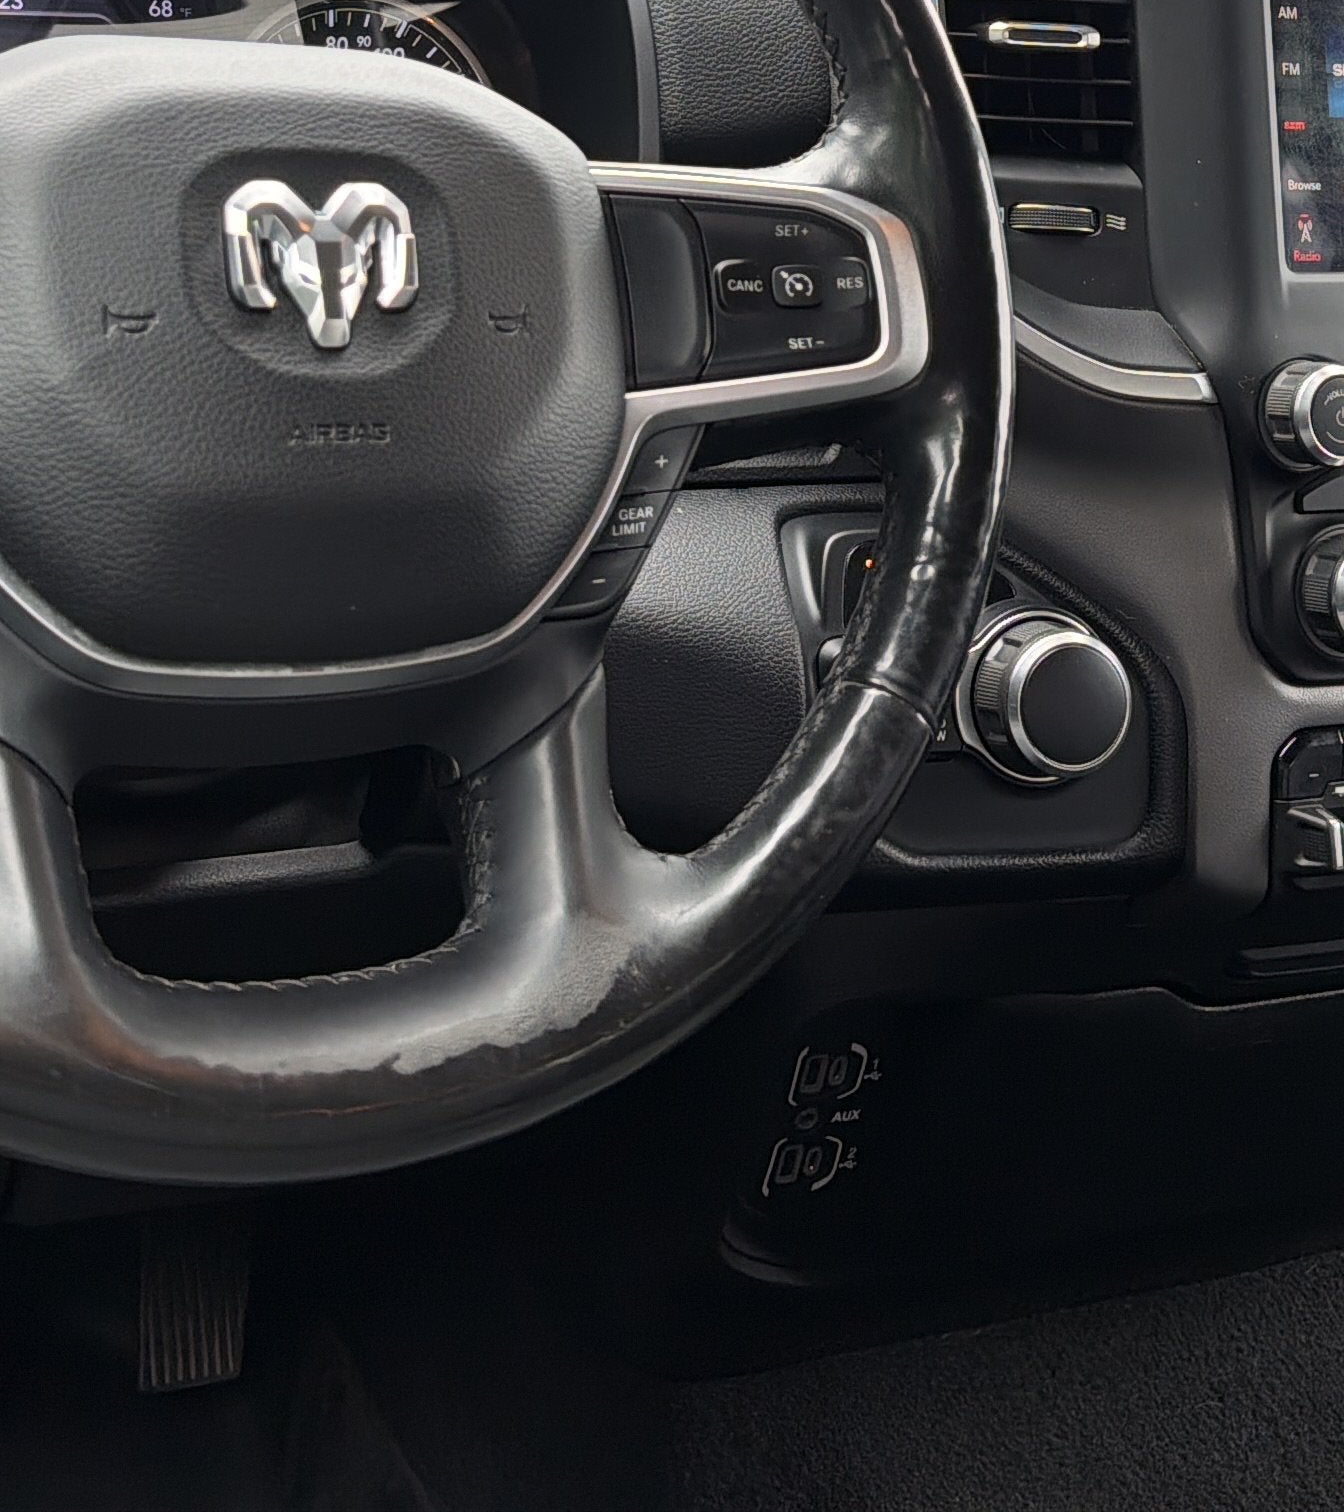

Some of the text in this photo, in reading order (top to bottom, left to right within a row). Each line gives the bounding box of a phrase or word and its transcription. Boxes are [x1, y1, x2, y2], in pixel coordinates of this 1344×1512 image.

[148, 0, 173, 18] 68
[1277, 6, 1298, 20] AM
[357, 35, 372, 47] 90
[1281, 62, 1301, 76] FM
[1288, 179, 1322, 192] Browse
[1293, 250, 1322, 262] Radio
[727, 277, 763, 293] CANC
[836, 275, 864, 290] RES
[618, 505, 654, 521] GEAR
[612, 521, 647, 537] LIMIT
[830, 1108, 862, 1123] AUX
